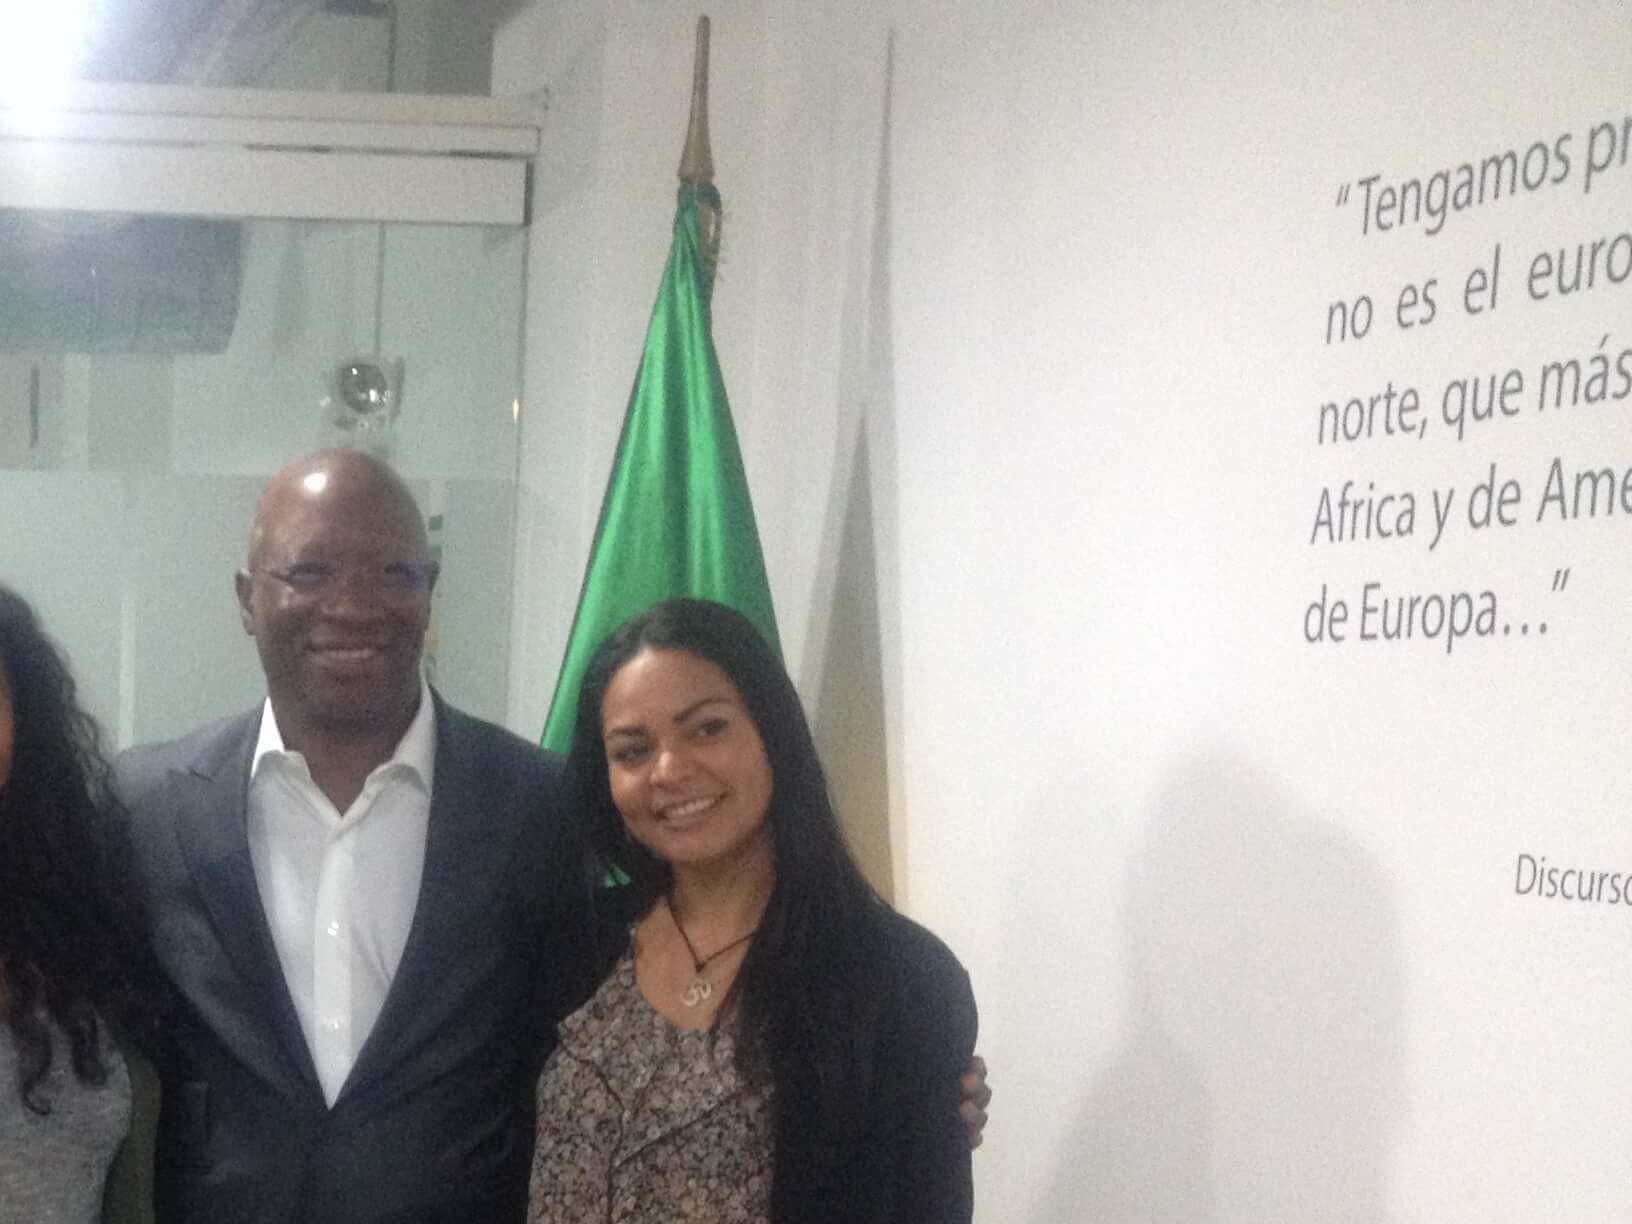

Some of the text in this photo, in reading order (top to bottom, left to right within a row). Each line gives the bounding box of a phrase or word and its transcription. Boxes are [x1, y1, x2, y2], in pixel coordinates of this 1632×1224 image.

[1326, 232, 1632, 345] no es el euro
[1318, 332, 1632, 445] norte, que más
[1310, 480, 1416, 545] Africa
[1430, 487, 1455, 552] y
[1467, 462, 1521, 530] de
[1303, 583, 1349, 643] de
